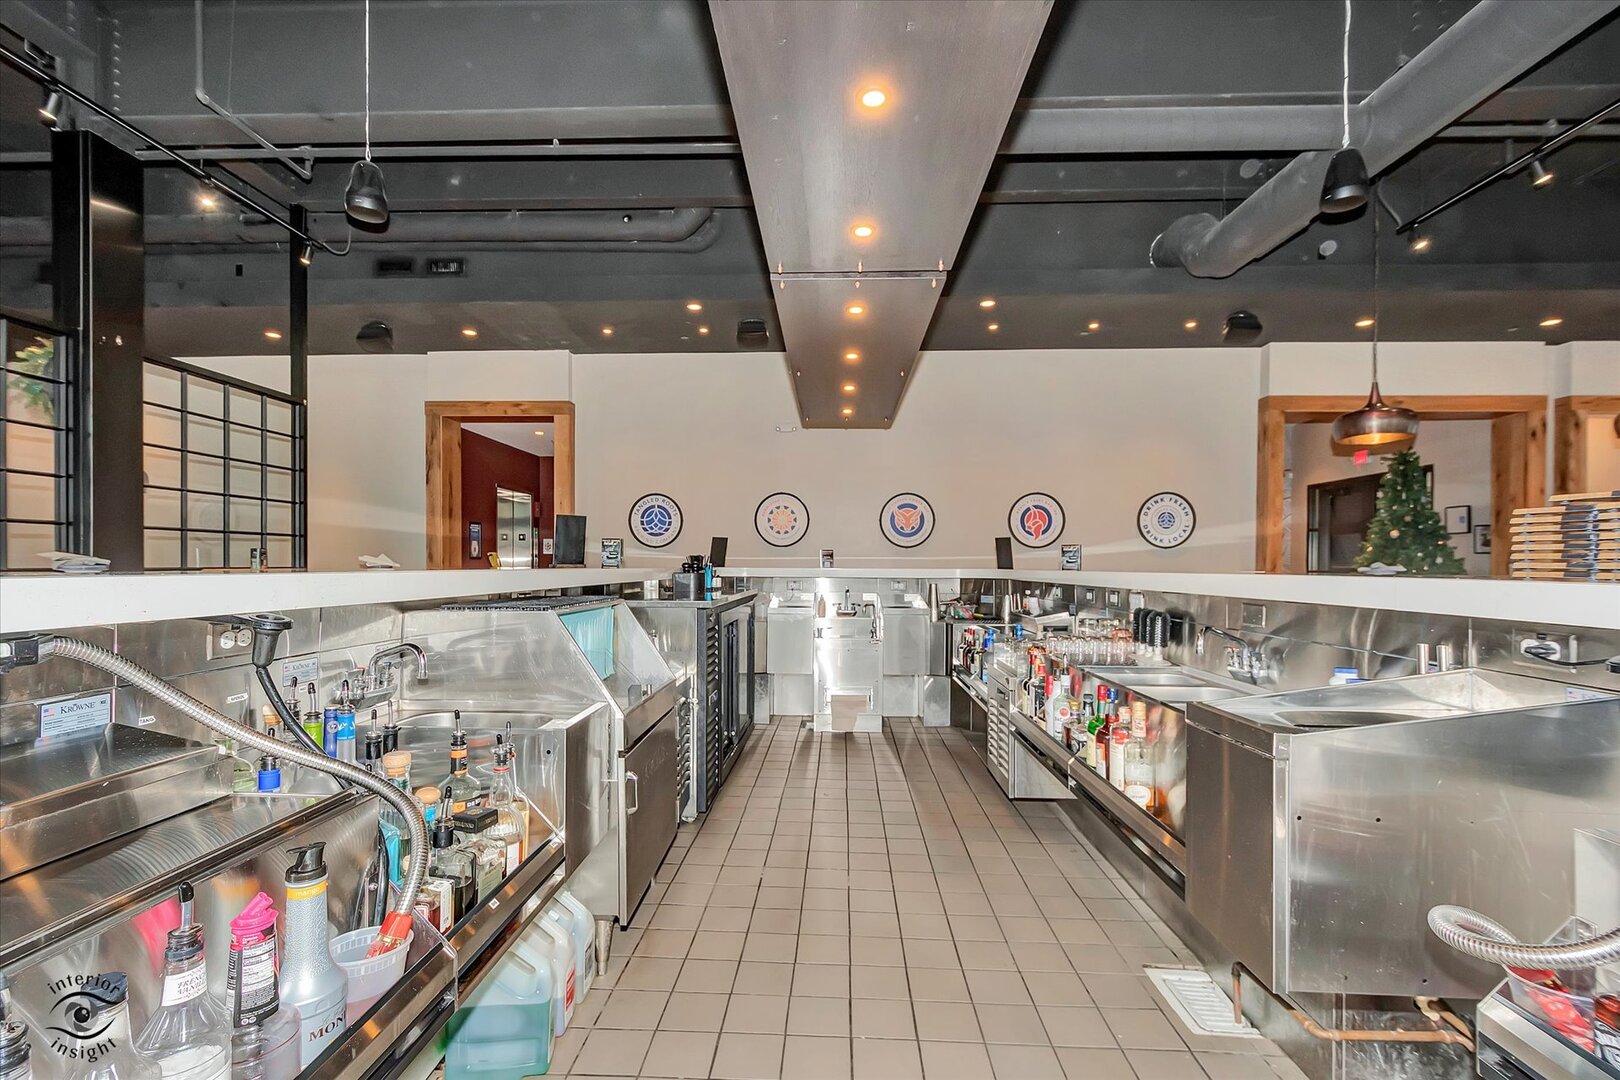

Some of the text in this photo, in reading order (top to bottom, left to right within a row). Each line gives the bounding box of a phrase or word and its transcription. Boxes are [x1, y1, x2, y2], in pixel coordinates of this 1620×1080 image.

[634, 497, 678, 517] TANGLED ROOTS
[1143, 497, 1189, 517] DRINK FRESH
[1143, 524, 1190, 544] DRINK LOCAL
[295, 887, 321, 897] mango
